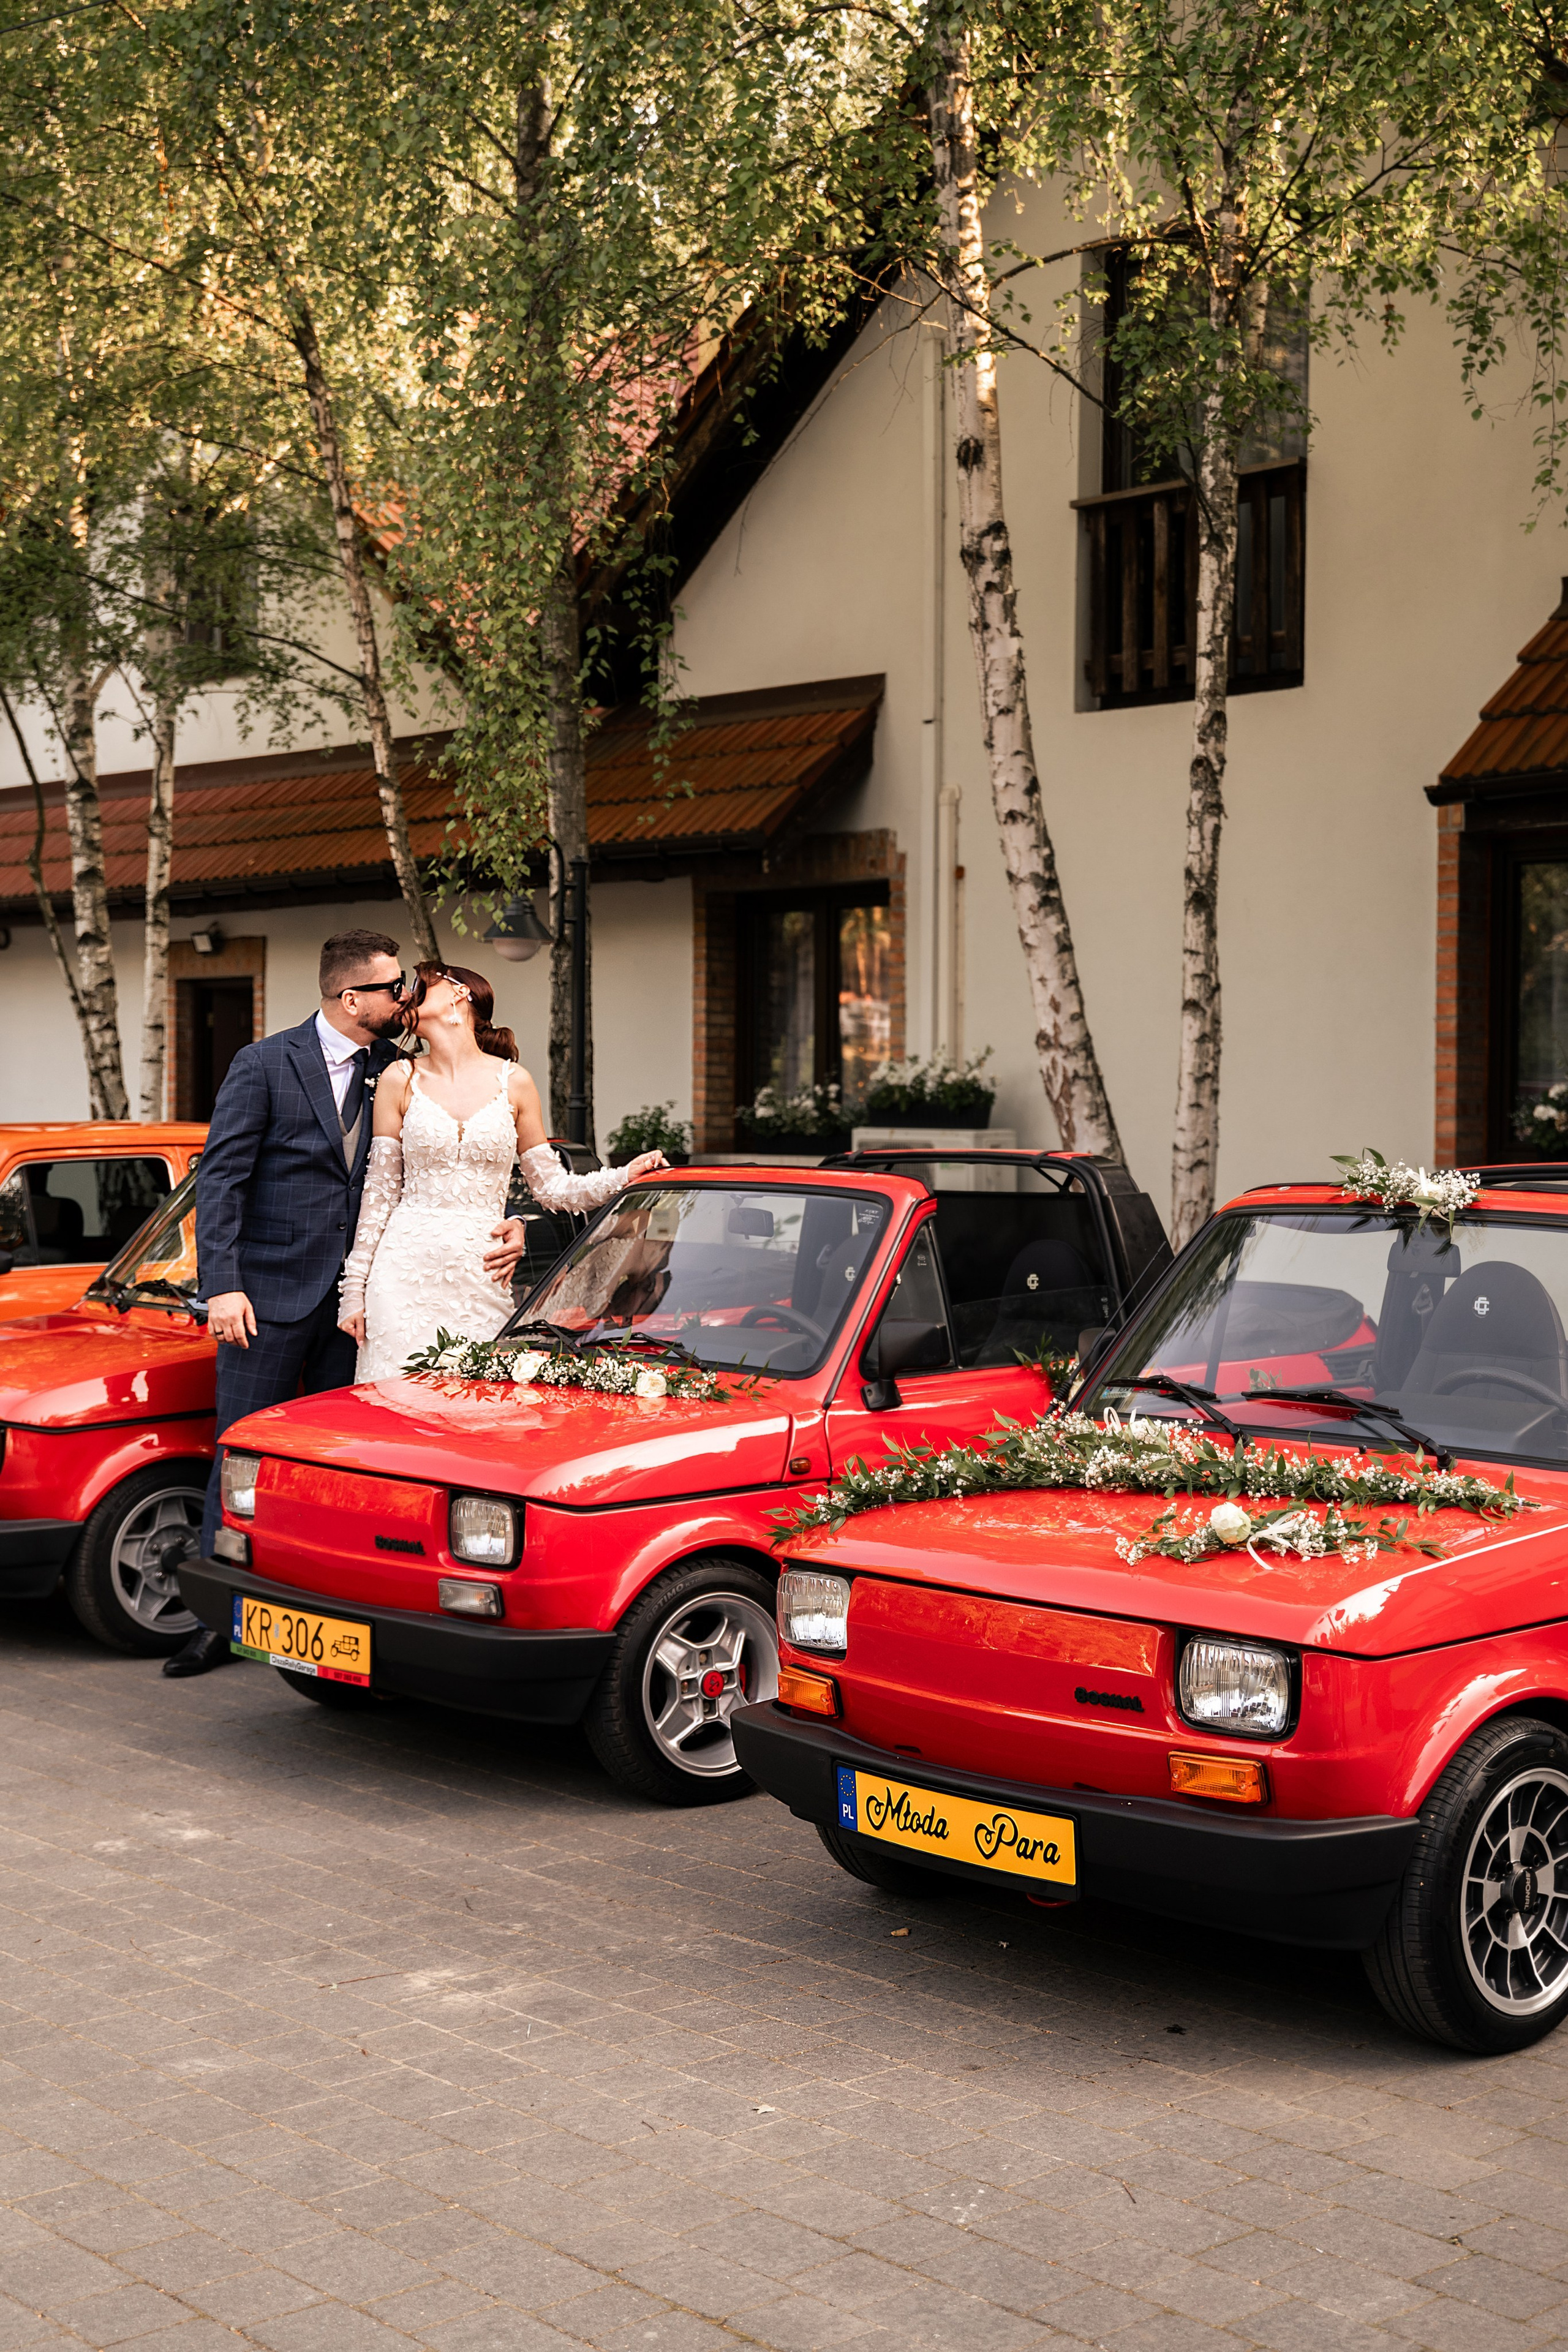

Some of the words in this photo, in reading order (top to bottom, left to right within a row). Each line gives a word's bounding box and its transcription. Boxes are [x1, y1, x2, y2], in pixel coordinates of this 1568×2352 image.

[646, 1583, 684, 1623] OPTIMO
[233, 1624, 242, 1638] PL
[246, 1604, 272, 1649] KR
[282, 1614, 324, 1662] 306
[1074, 1686, 1145, 1713] BOSMAL
[842, 1803, 854, 1820] PL
[865, 1786, 949, 1840] Młoda
[974, 1813, 1061, 1865] Para
